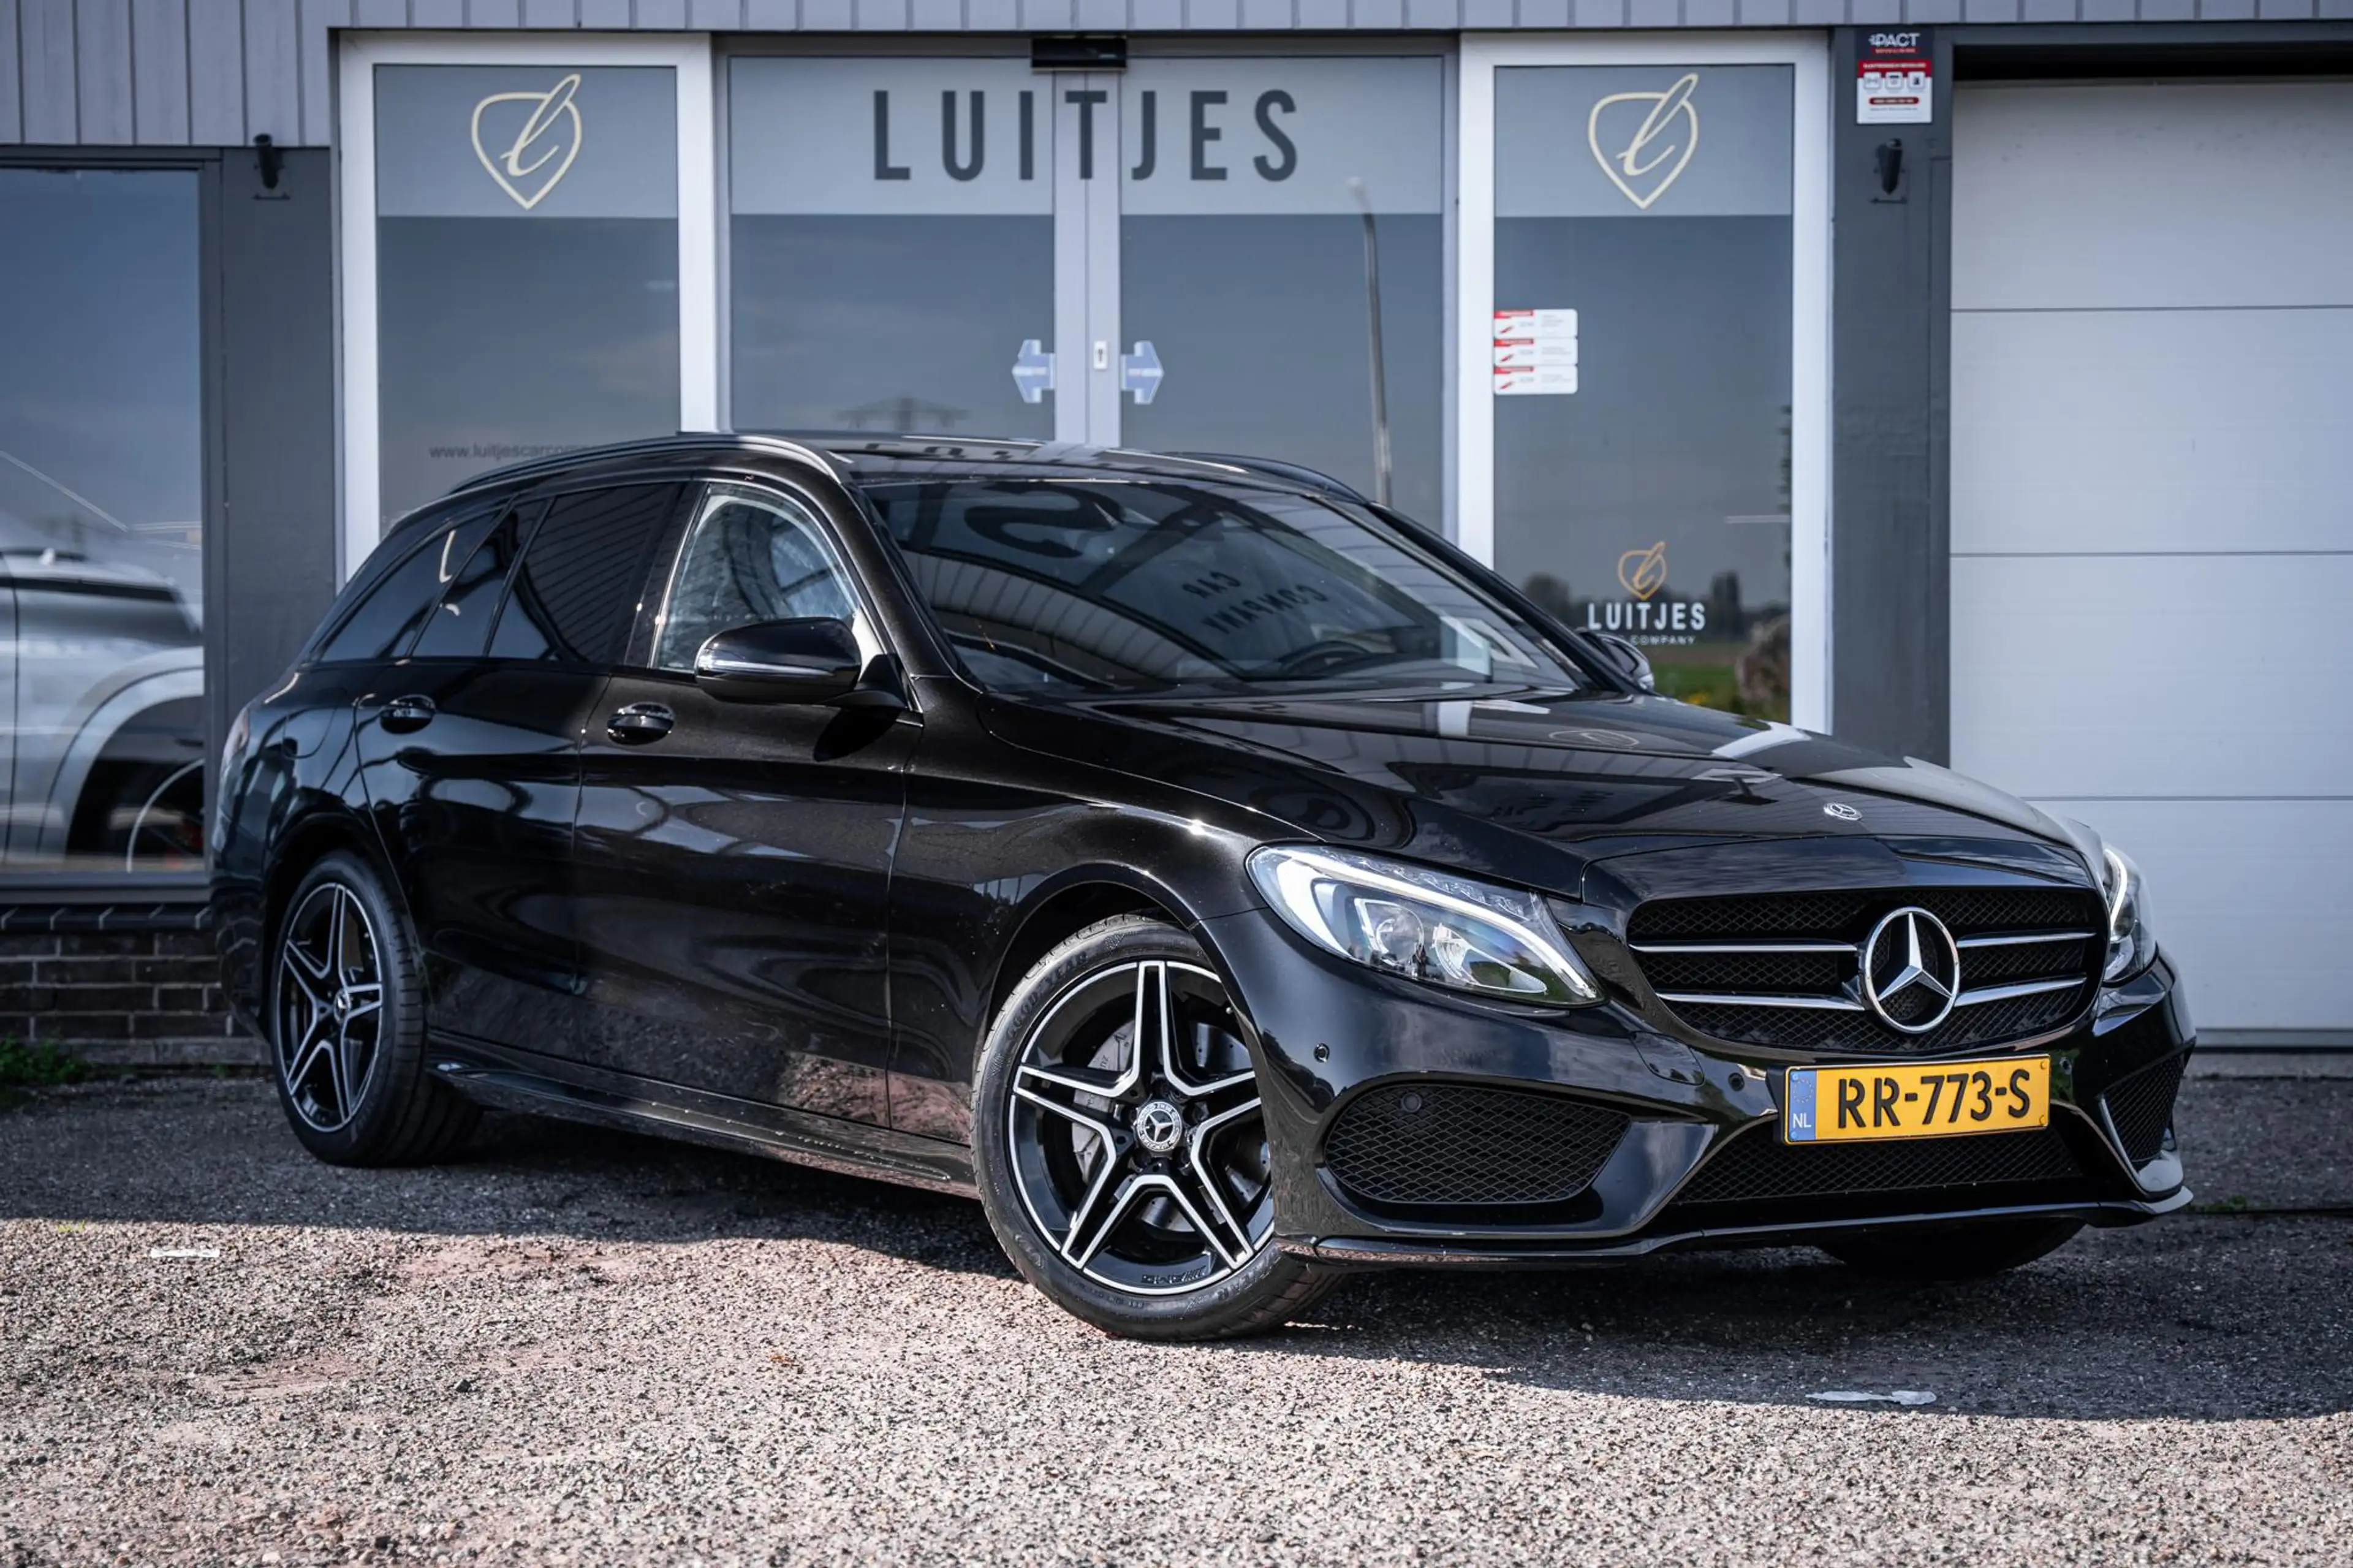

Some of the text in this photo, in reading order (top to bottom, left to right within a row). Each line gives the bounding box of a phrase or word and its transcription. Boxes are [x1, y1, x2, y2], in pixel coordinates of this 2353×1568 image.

[873, 89, 1298, 182] LUITJES
[1587, 602, 1707, 631] LUITJES
[1630, 634, 1696, 645] COMPANY
[1838, 1068, 2031, 1129] RR-773-S
[1792, 1112, 1812, 1129] NL
